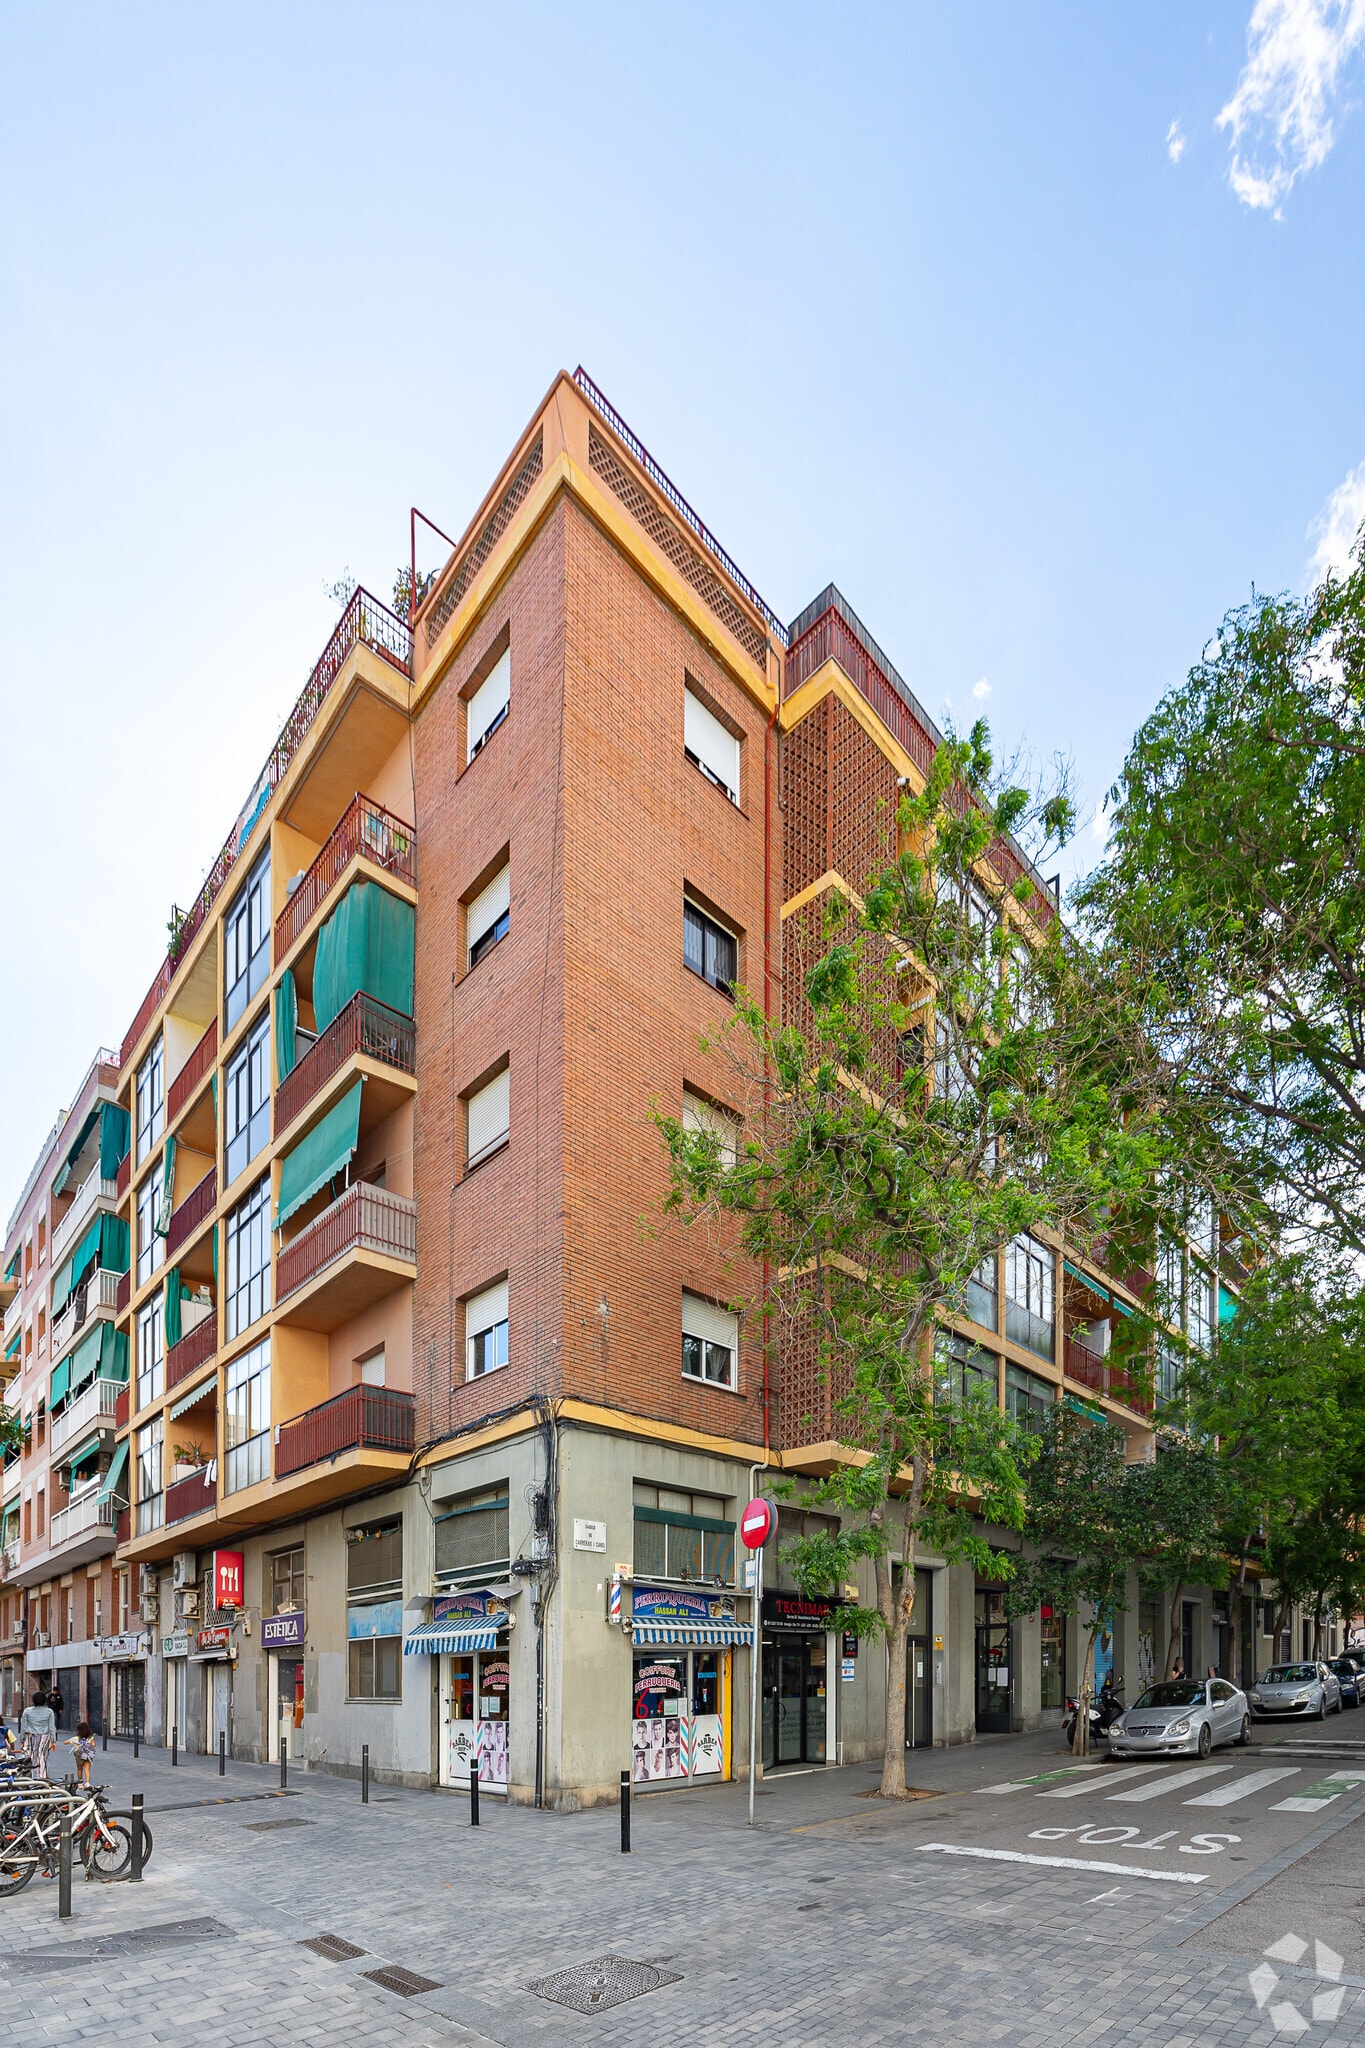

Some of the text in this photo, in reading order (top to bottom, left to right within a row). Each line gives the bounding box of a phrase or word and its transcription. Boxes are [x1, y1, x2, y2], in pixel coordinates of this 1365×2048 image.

[435, 1596, 484, 1618] PERRUQUERIA
[634, 1592, 706, 1613] PERRUQUERIA
[776, 1600, 830, 1616] TECNIMAR
[654, 1607, 677, 1616] HASSAN
[679, 1608, 689, 1617] ALI
[265, 1620, 298, 1639] ESTÈTICA
[639, 1665, 675, 1678] COIFFURE
[634, 1677, 681, 1693] PERRUQUERIA
[635, 1688, 649, 1719] 6
[452, 1737, 472, 1750] BARBER
[697, 1737, 717, 1747] BARBER
[1027, 1824, 1242, 1854] STOP
